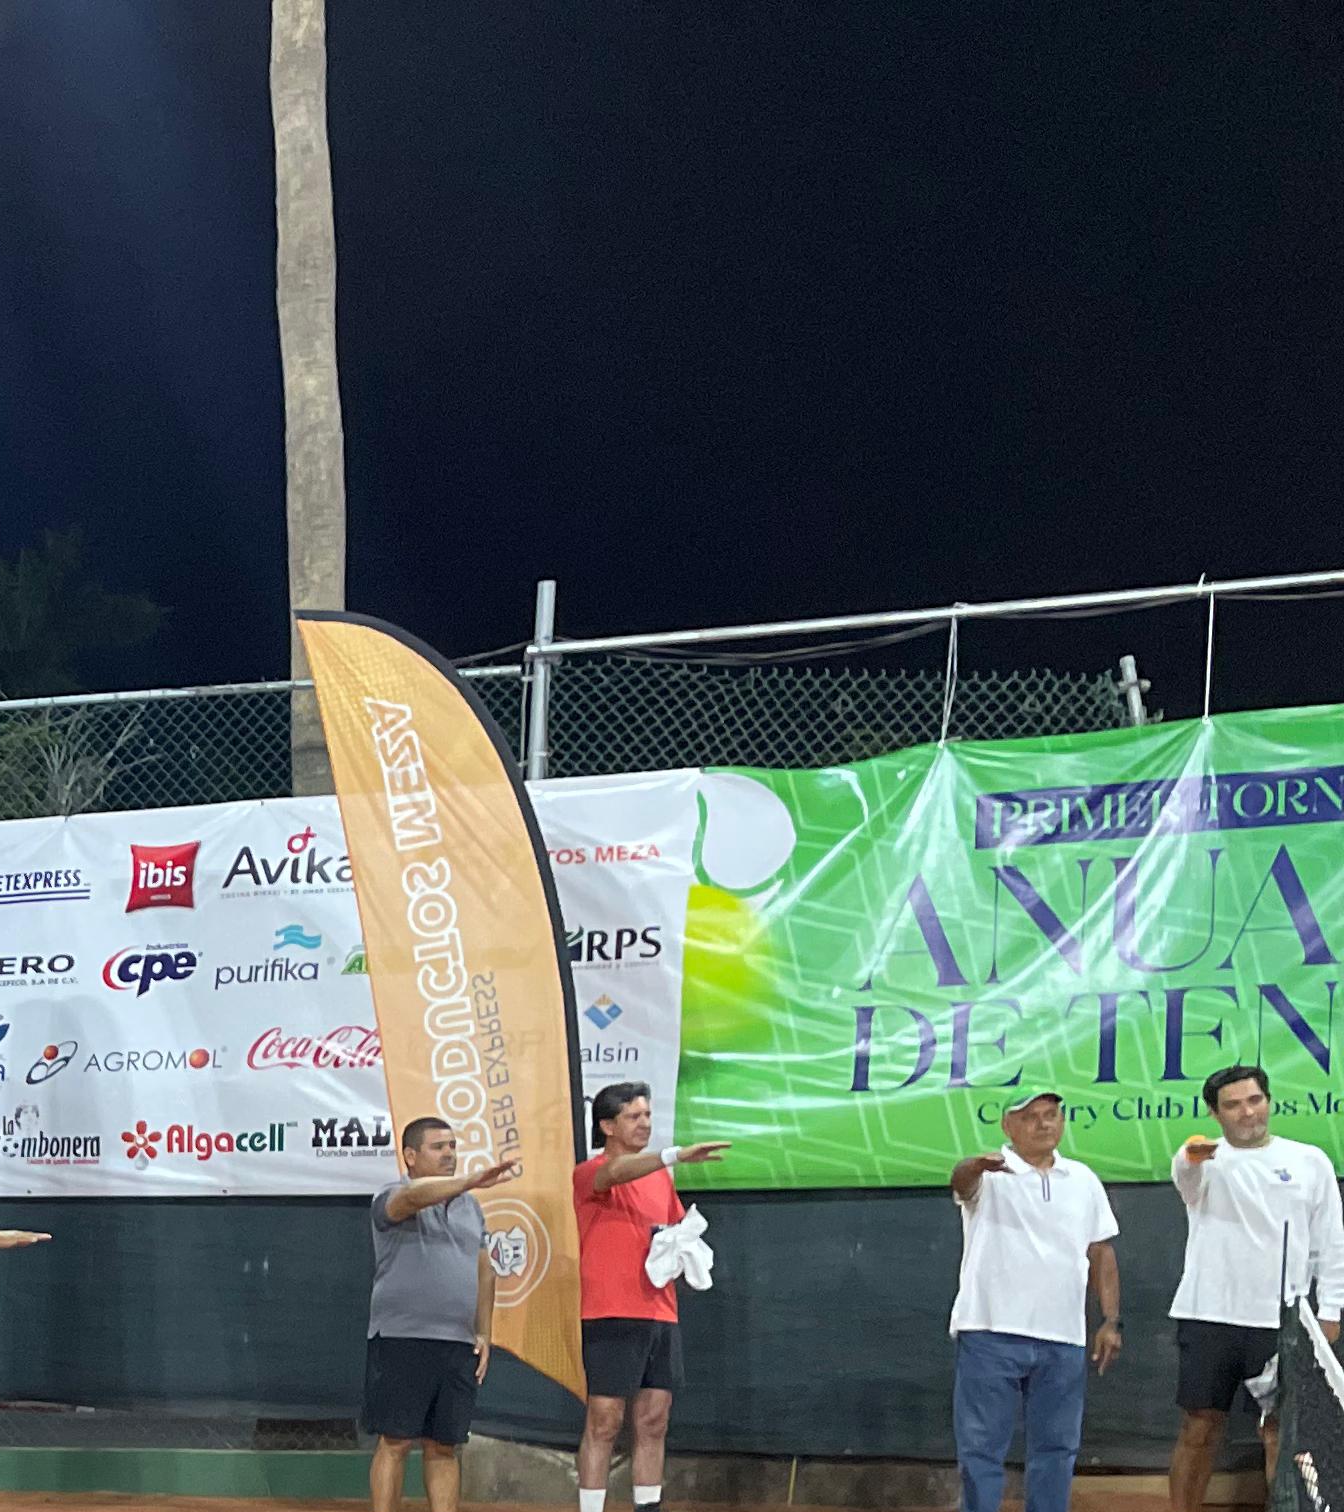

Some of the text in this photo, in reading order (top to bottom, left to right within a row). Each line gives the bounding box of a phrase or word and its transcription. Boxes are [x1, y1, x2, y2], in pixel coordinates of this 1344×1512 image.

[594, 843, 661, 864] MEZA
[138, 860, 187, 889] ibis
[586, 926, 662, 962] RPS
[117, 950, 197, 998] cpe
[215, 957, 319, 990] purifika
[83, 1048, 224, 1073] AGROMOL
[849, 999, 1024, 1092] DE
[1113, 1096, 1184, 1121] Club
[167, 1122, 285, 1161] Algacell
